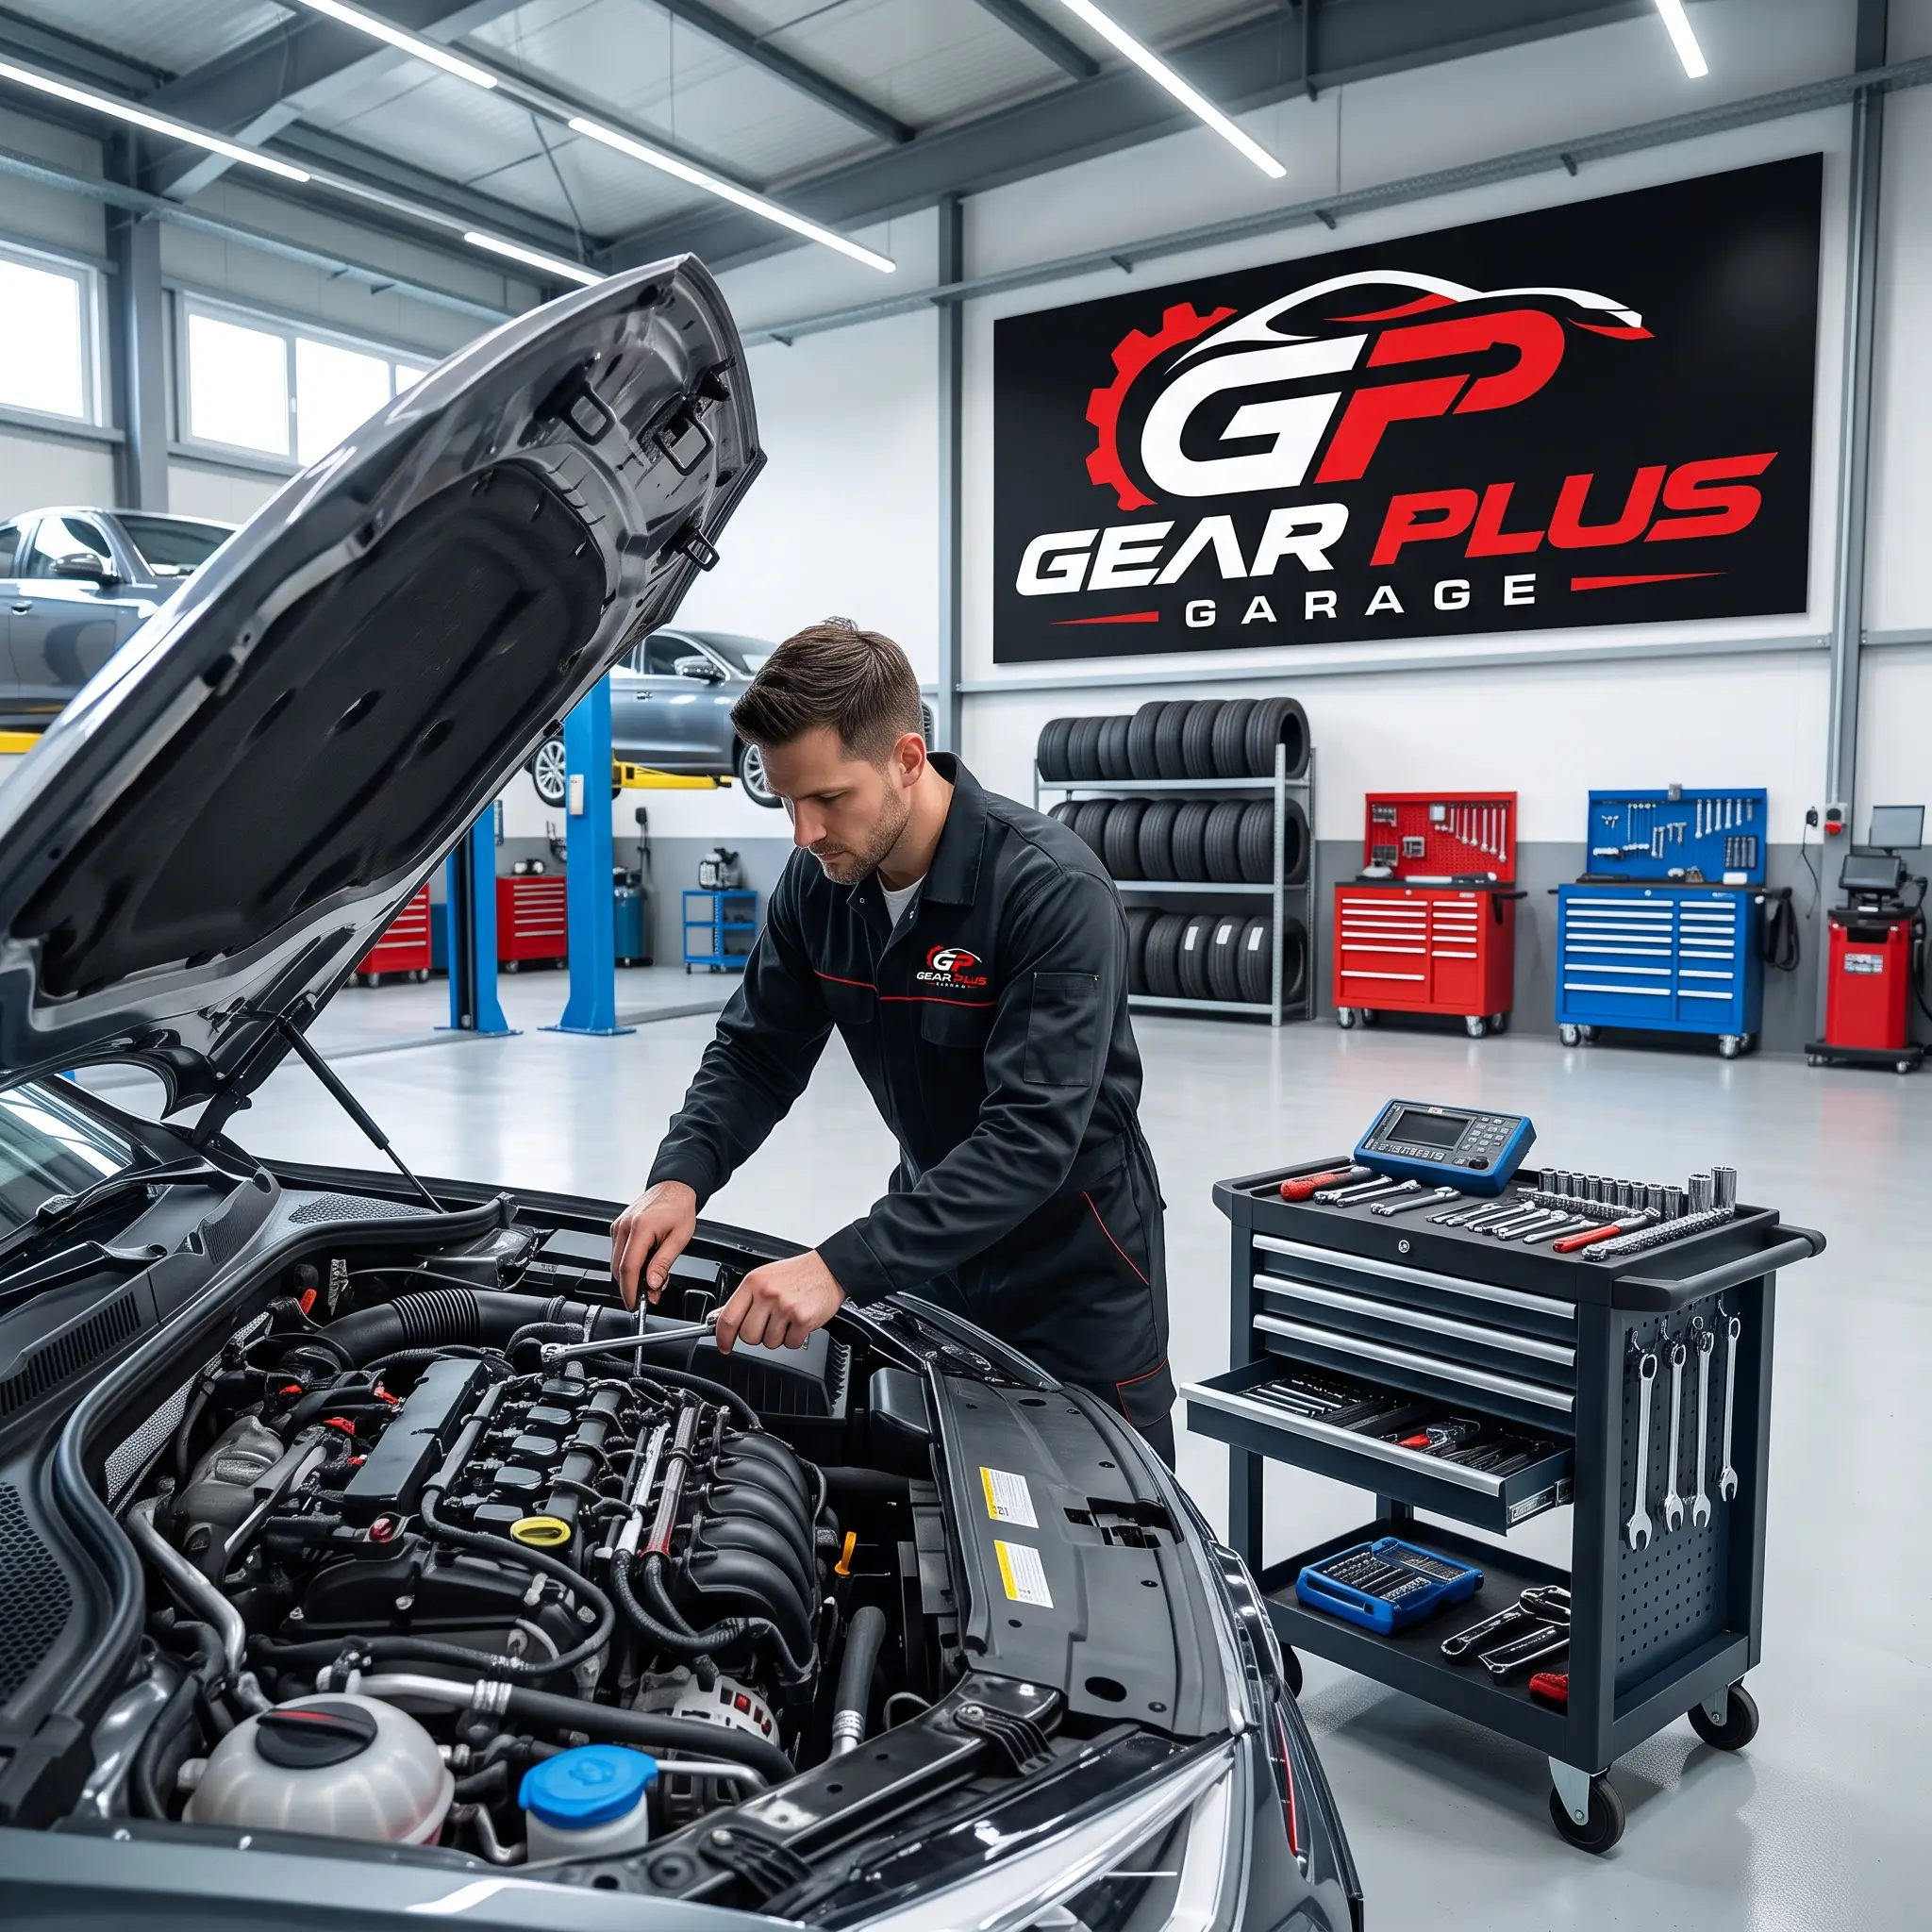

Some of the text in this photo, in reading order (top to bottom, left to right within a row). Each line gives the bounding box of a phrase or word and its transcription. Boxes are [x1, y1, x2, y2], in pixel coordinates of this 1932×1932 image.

[1141, 308, 1565, 497] GP
[1015, 452, 1778, 596] GEAR PLUS
[1185, 573, 1537, 628] GARAGE
[916, 972, 952, 982] GEAR
[933, 953, 974, 973] GP
